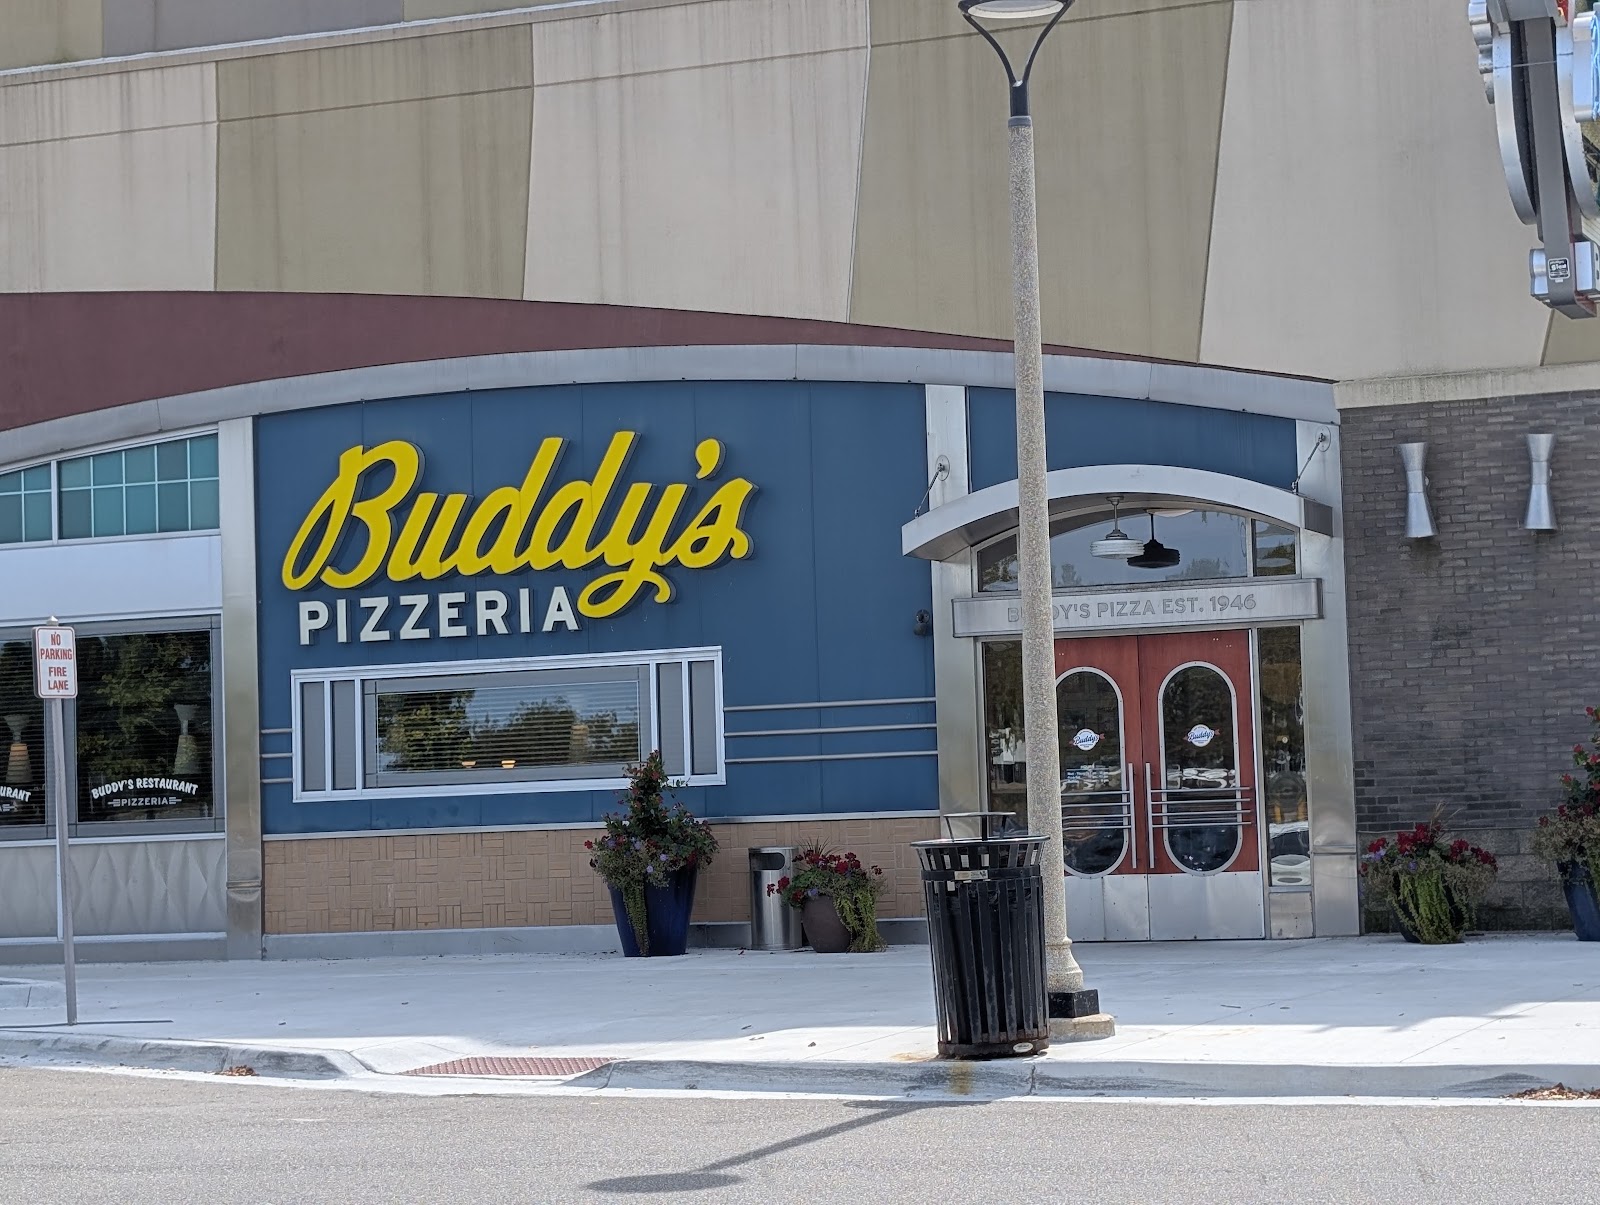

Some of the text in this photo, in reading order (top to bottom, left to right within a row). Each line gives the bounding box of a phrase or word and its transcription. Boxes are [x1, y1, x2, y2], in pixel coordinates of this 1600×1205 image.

[281, 431, 760, 619] Buddy's
[1097, 600, 1156, 618] PIZZA
[1162, 597, 1204, 614] EST.
[1209, 594, 1257, 612] 1946
[299, 586, 580, 646] PIZZERIA
[50, 633, 61, 646] NO
[40, 648, 73, 660] PARKING
[48, 666, 67, 677] FIRE
[48, 680, 69, 690] LANE
[91, 778, 198, 799] BUDDY'S RESTAURANT
[121, 797, 168, 806] PIZZERIA
